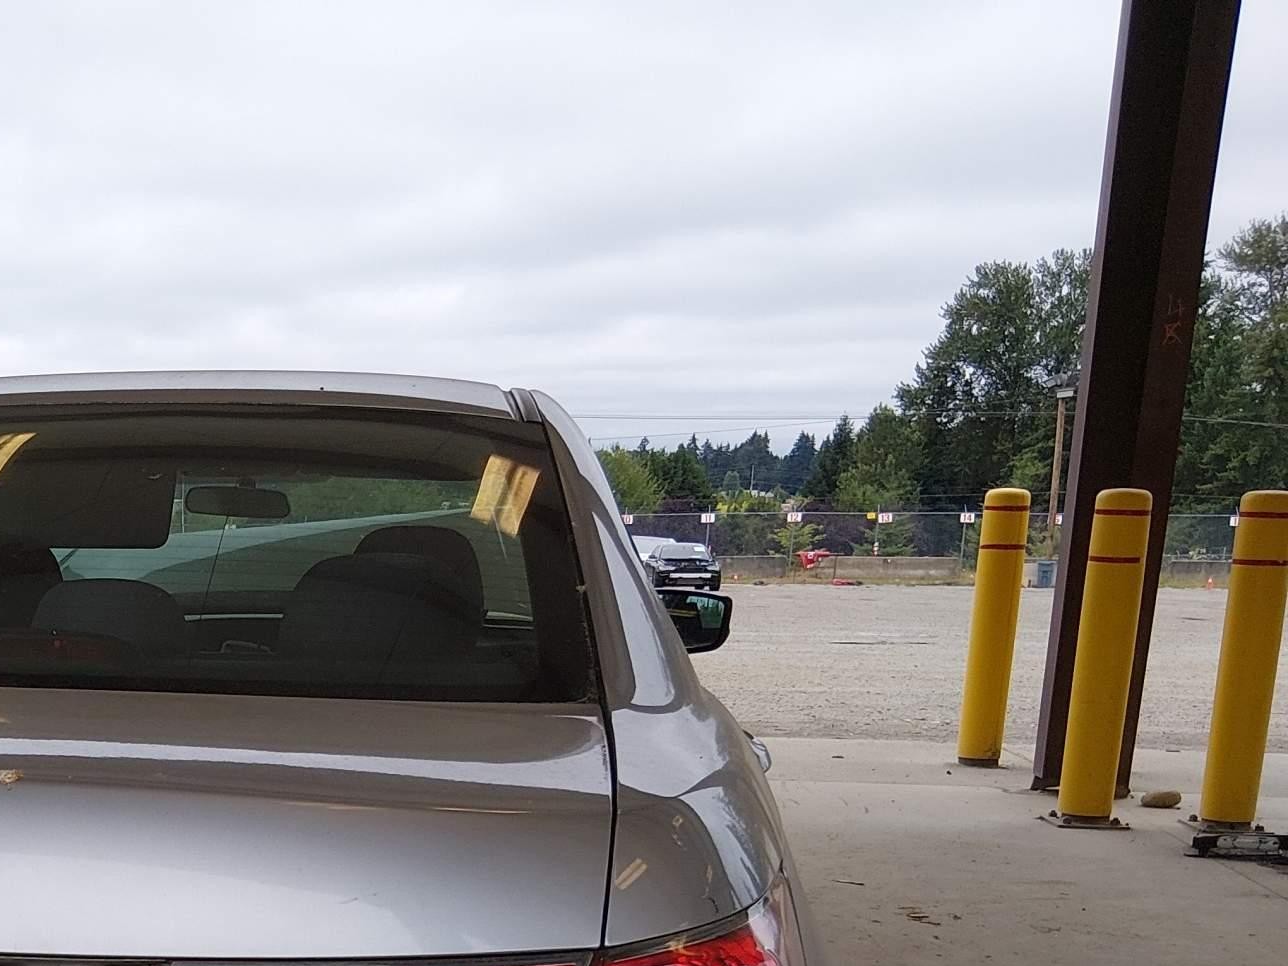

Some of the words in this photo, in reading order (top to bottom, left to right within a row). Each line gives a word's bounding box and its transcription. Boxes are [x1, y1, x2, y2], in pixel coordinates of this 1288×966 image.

[790, 512, 799, 522] 12
[880, 513, 890, 522] 13
[962, 512, 972, 522] 14
